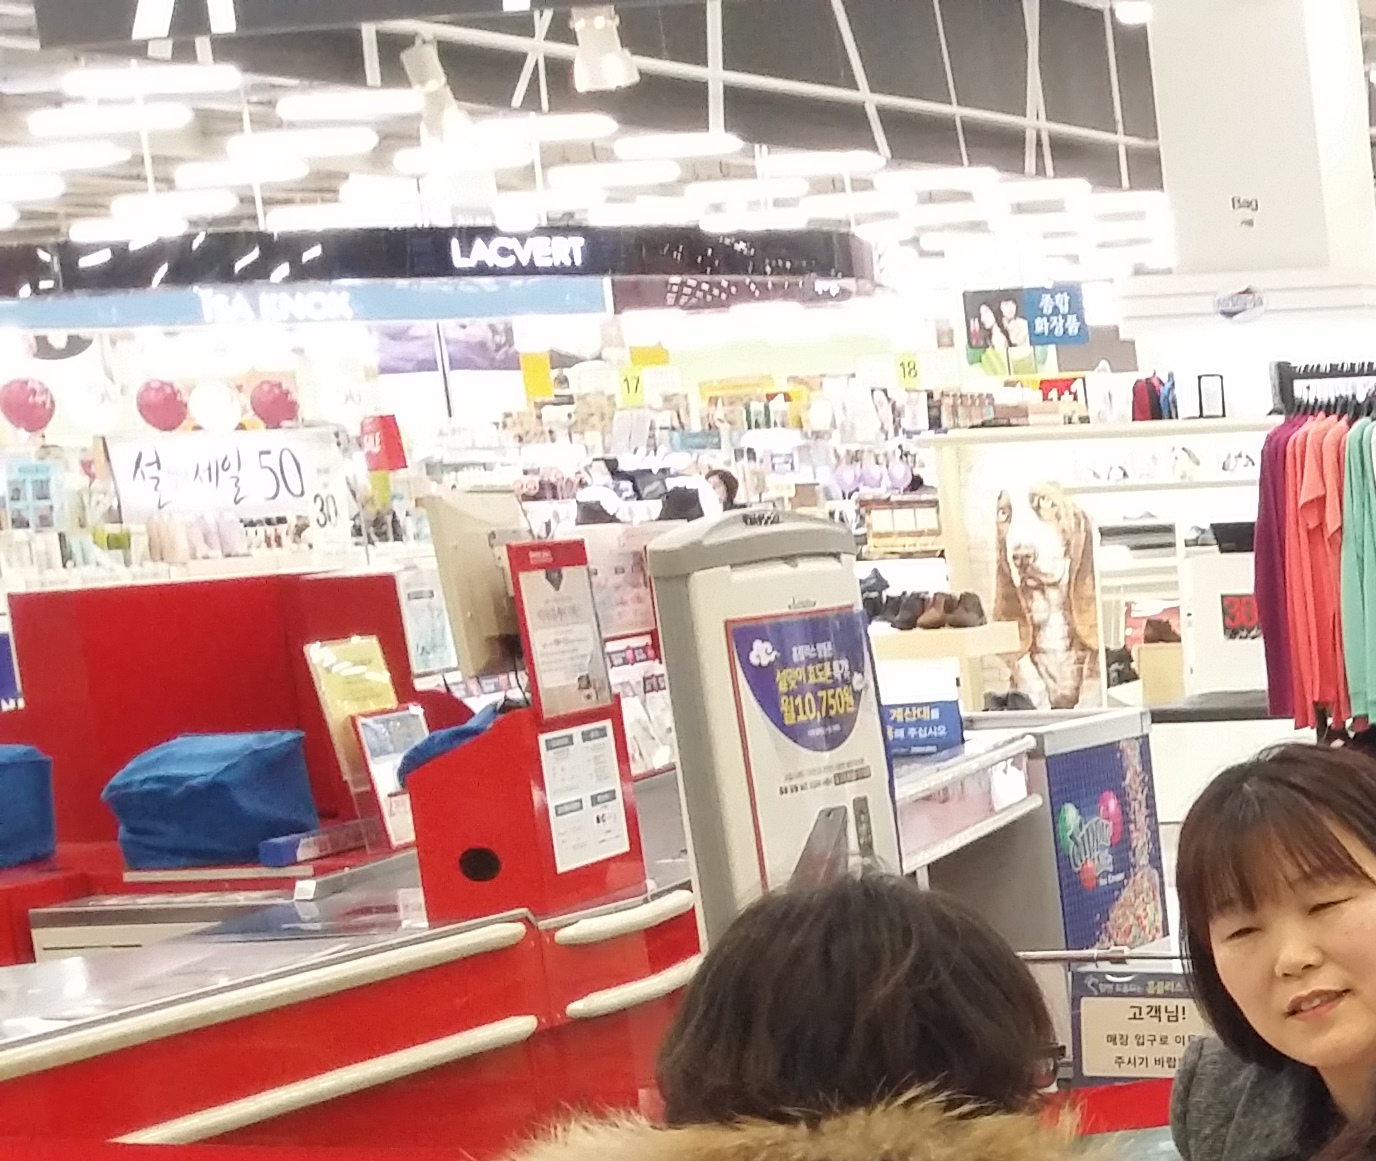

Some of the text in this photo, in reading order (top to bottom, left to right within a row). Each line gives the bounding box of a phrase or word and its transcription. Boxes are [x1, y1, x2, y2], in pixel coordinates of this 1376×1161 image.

[1231, 196, 1259, 211] Bag
[450, 235, 586, 268] LACVERT
[1034, 314, 1081, 337] 화장품
[898, 360, 918, 379] 18
[622, 376, 640, 395] 17
[133, 447, 305, 510] 설 세일 50
[312, 492, 338, 529] 30
[1127, 1004, 1187, 1023] 고객님!
[1106, 1033, 1129, 1046] 매장
[1134, 1034, 1169, 1046] 입구로
[1114, 1054, 1149, 1069] 주시기
